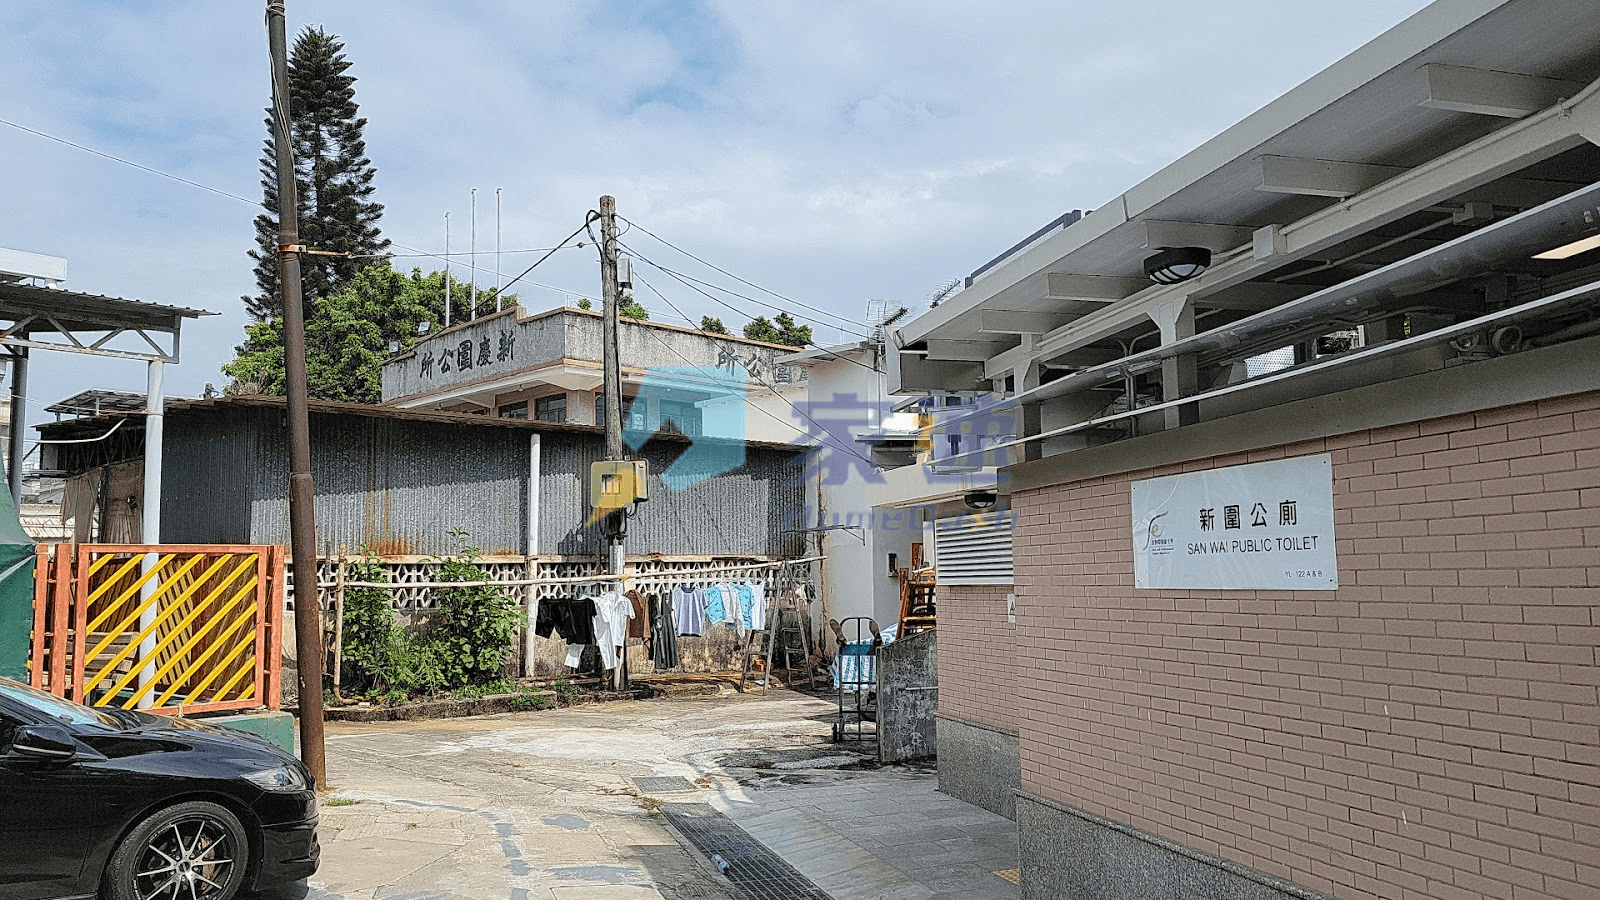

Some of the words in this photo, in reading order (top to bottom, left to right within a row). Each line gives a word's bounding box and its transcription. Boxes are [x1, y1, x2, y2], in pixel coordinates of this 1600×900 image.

[1187, 542, 1207, 556] SAN
[1209, 540, 1229, 554] WAI
[1232, 538, 1272, 553] PUBLIC
[1275, 535, 1319, 552] TOILET
[1284, 570, 1292, 578] YL
[1295, 570, 1306, 578] 122
